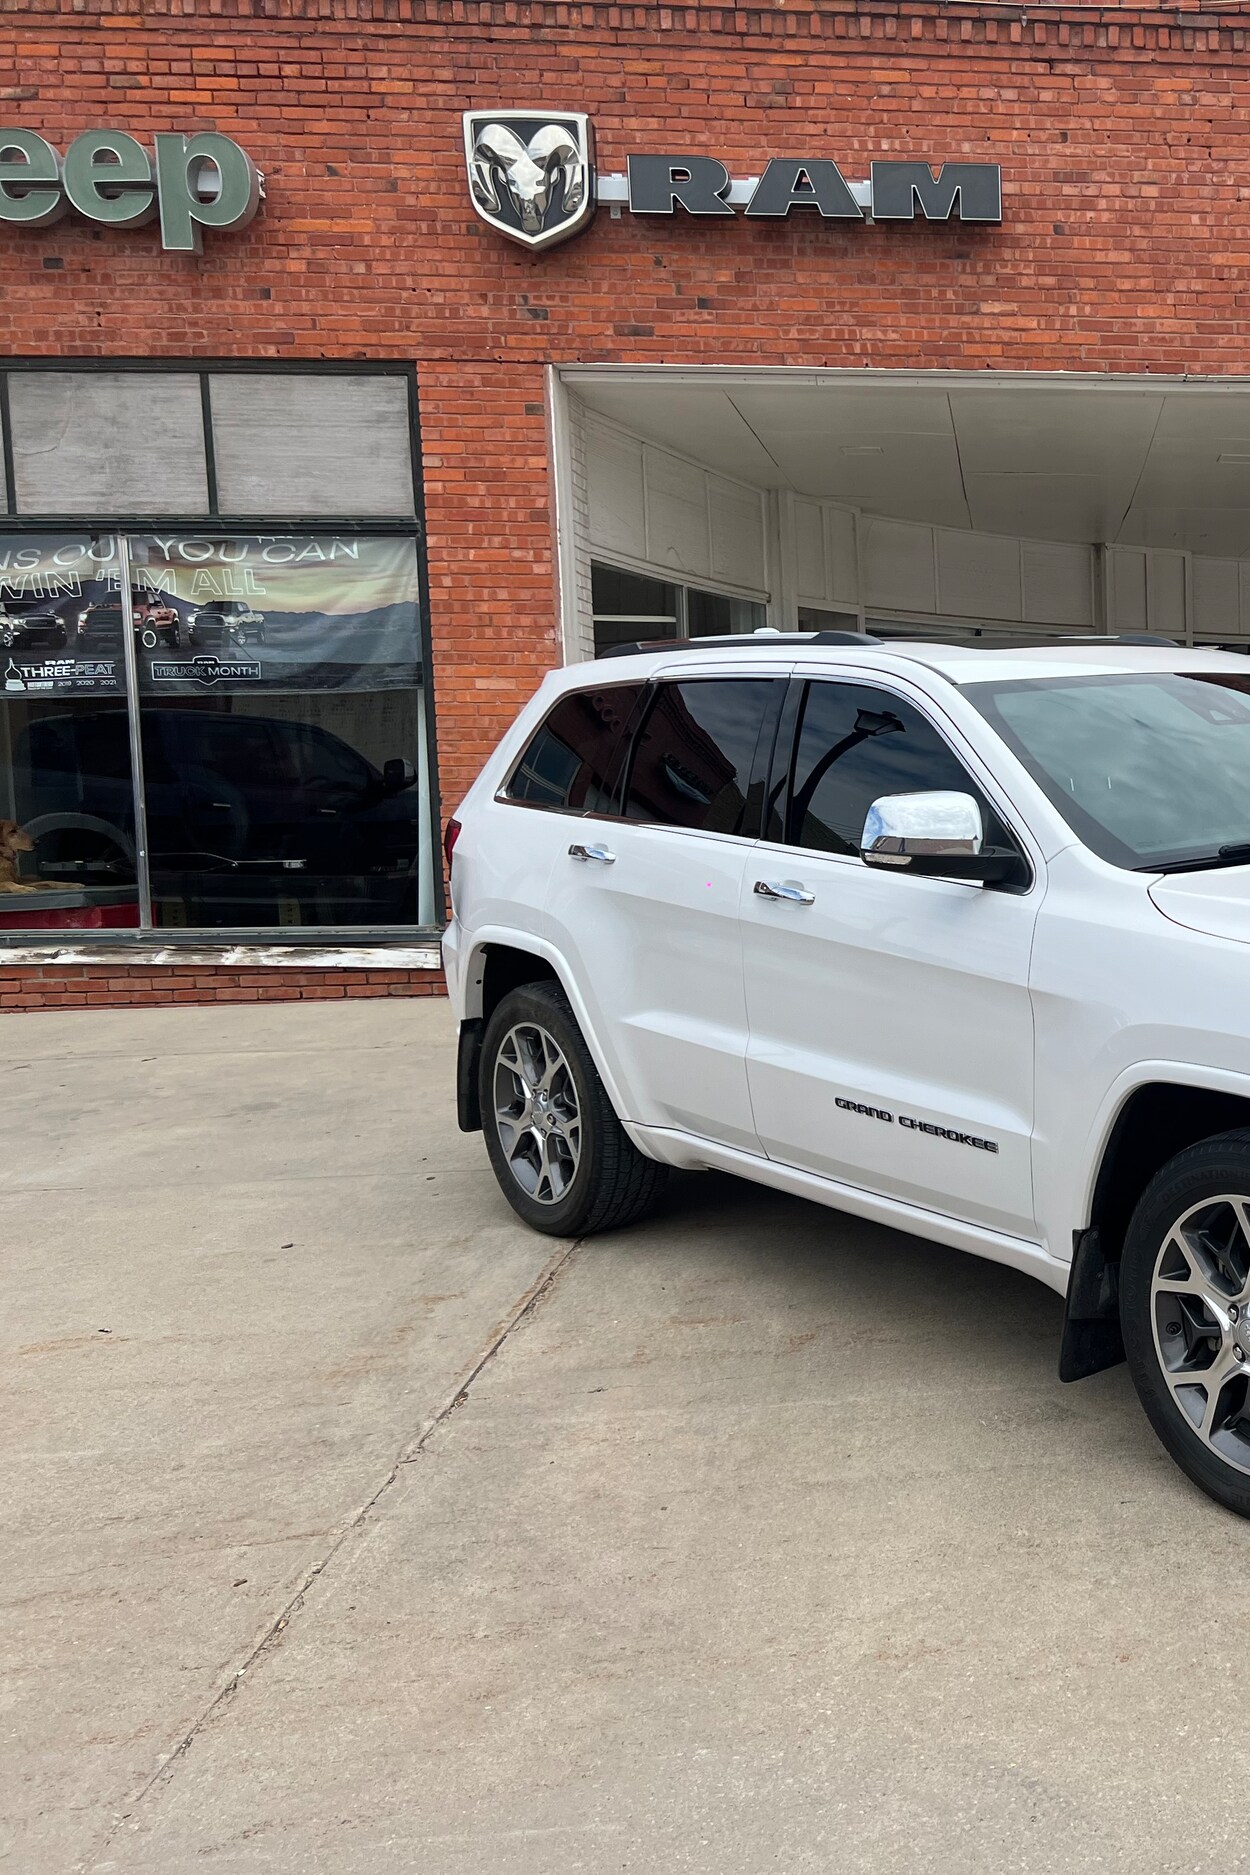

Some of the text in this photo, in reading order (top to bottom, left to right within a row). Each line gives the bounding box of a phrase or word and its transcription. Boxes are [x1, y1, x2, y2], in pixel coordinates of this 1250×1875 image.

[626, 153, 1002, 222] RAM
[151, 535, 248, 562] YOU
[262, 538, 360, 564] CAN
[190, 568, 267, 596] ALL
[20, 664, 117, 678] THREE-PEAT
[76, 679, 95, 687] 2020
[100, 679, 118, 687] 2021
[154, 666, 259, 677] TRUCK MONTH
[834, 1096, 1000, 1155] GRAND CHEROKEE
